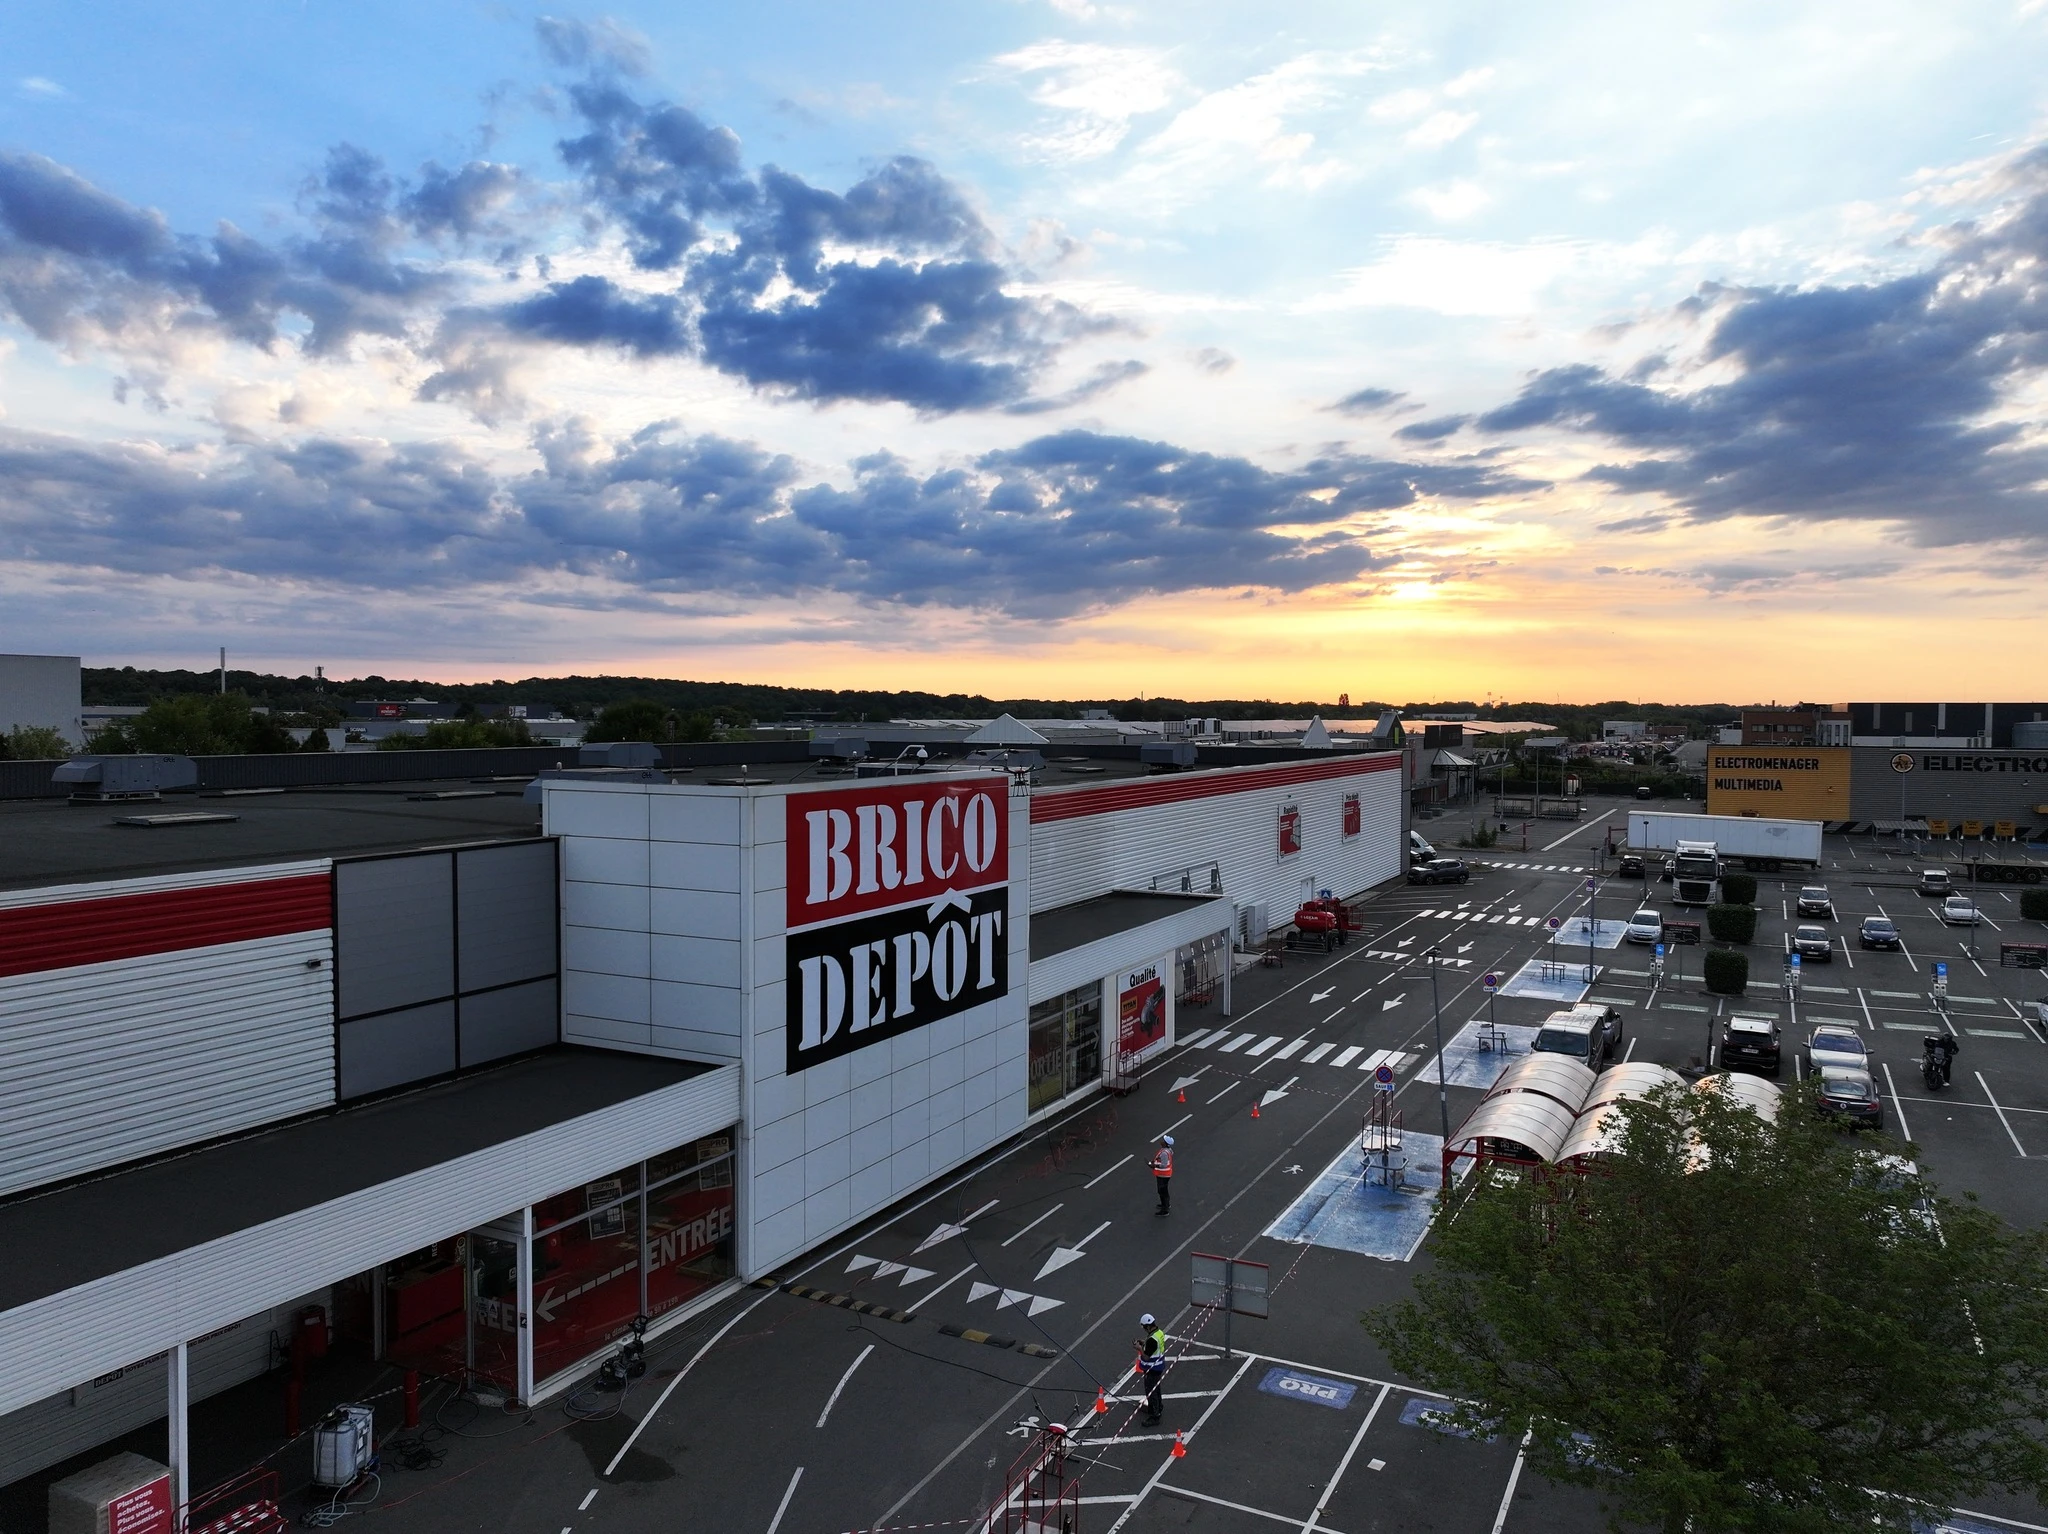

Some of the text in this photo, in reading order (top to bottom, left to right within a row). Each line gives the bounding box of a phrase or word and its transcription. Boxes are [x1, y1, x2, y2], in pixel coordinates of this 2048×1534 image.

[1714, 756, 1820, 771] ELECTROMENAGER
[1714, 778, 1783, 792] MULTIMEDIA
[805, 793, 997, 905] BRICO
[798, 887, 1002, 1052] DEPÔT
[1129, 965, 1156, 988] Qualité
[1123, 1000, 1137, 1011] TITAN
[647, 1204, 733, 1272] ENTRÉE
[1279, 1378, 1338, 1400] PRO
[117, 1489, 153, 1510] Plus vous
[117, 1505, 154, 1526] Plus vous
